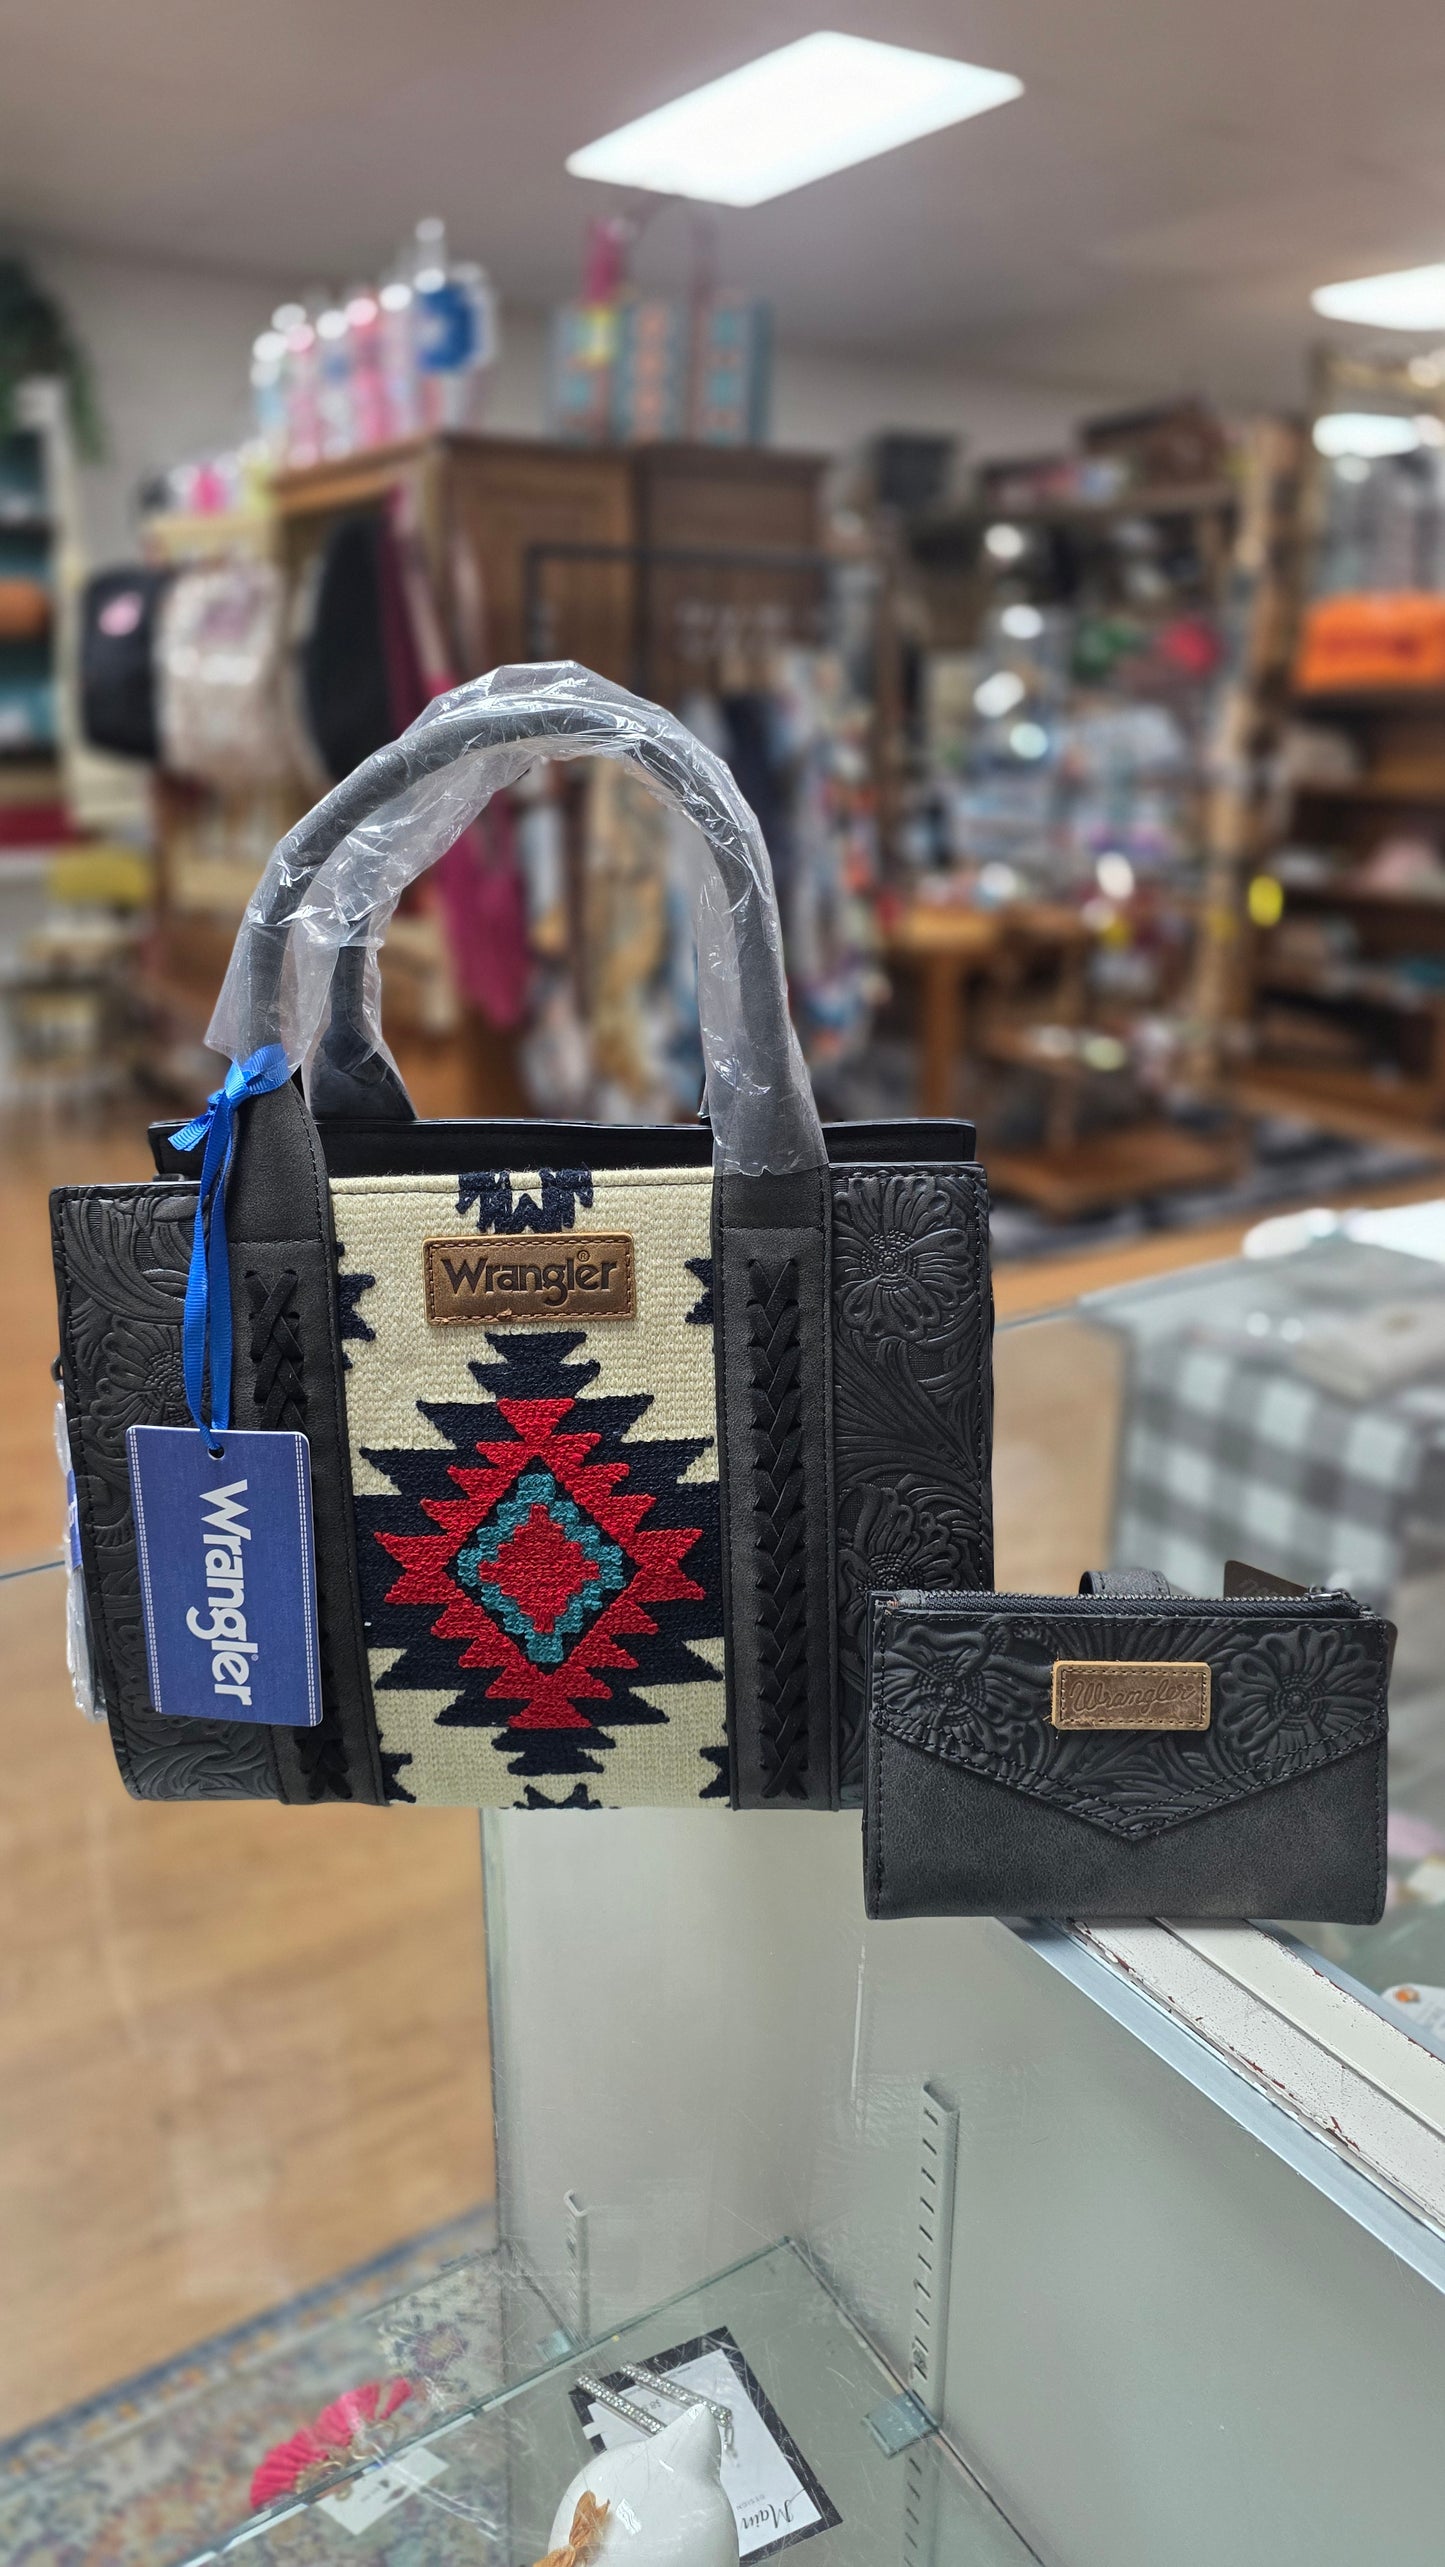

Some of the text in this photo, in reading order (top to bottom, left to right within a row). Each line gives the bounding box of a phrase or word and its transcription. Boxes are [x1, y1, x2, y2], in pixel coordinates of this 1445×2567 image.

[441, 1256, 617, 1307] Wrangler
[186, 1479, 258, 1706] Wrangler
[1070, 1679, 1196, 1715] Wrangler
[741, 2497, 795, 2529] Main
